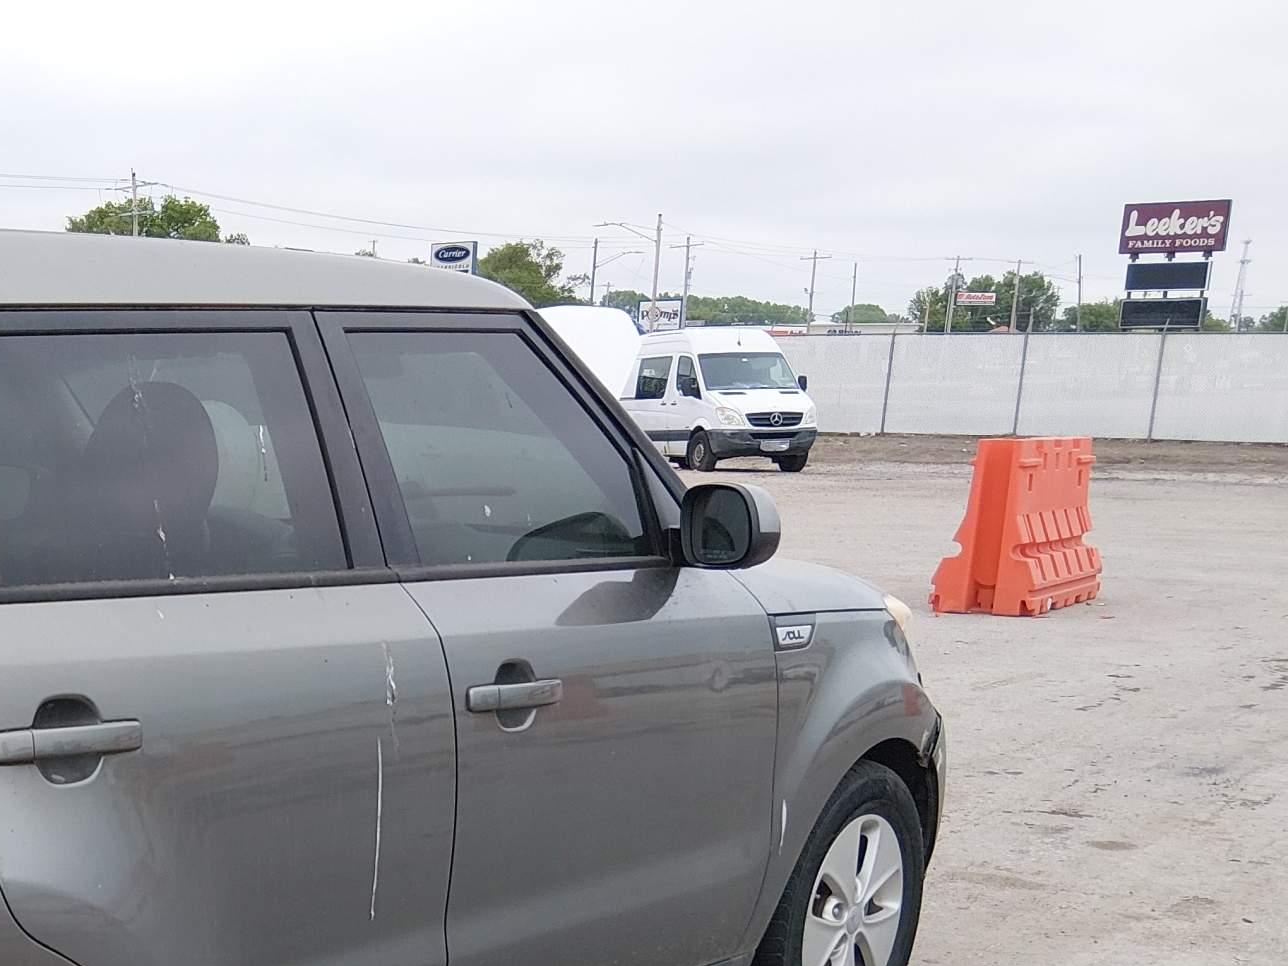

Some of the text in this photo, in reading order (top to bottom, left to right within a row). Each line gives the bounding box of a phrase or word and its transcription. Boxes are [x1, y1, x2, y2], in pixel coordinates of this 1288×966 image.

[1125, 209, 1224, 237] Leeker's
[1128, 238, 1215, 248] FAMILY FOODS
[438, 249, 466, 259] Carrier
